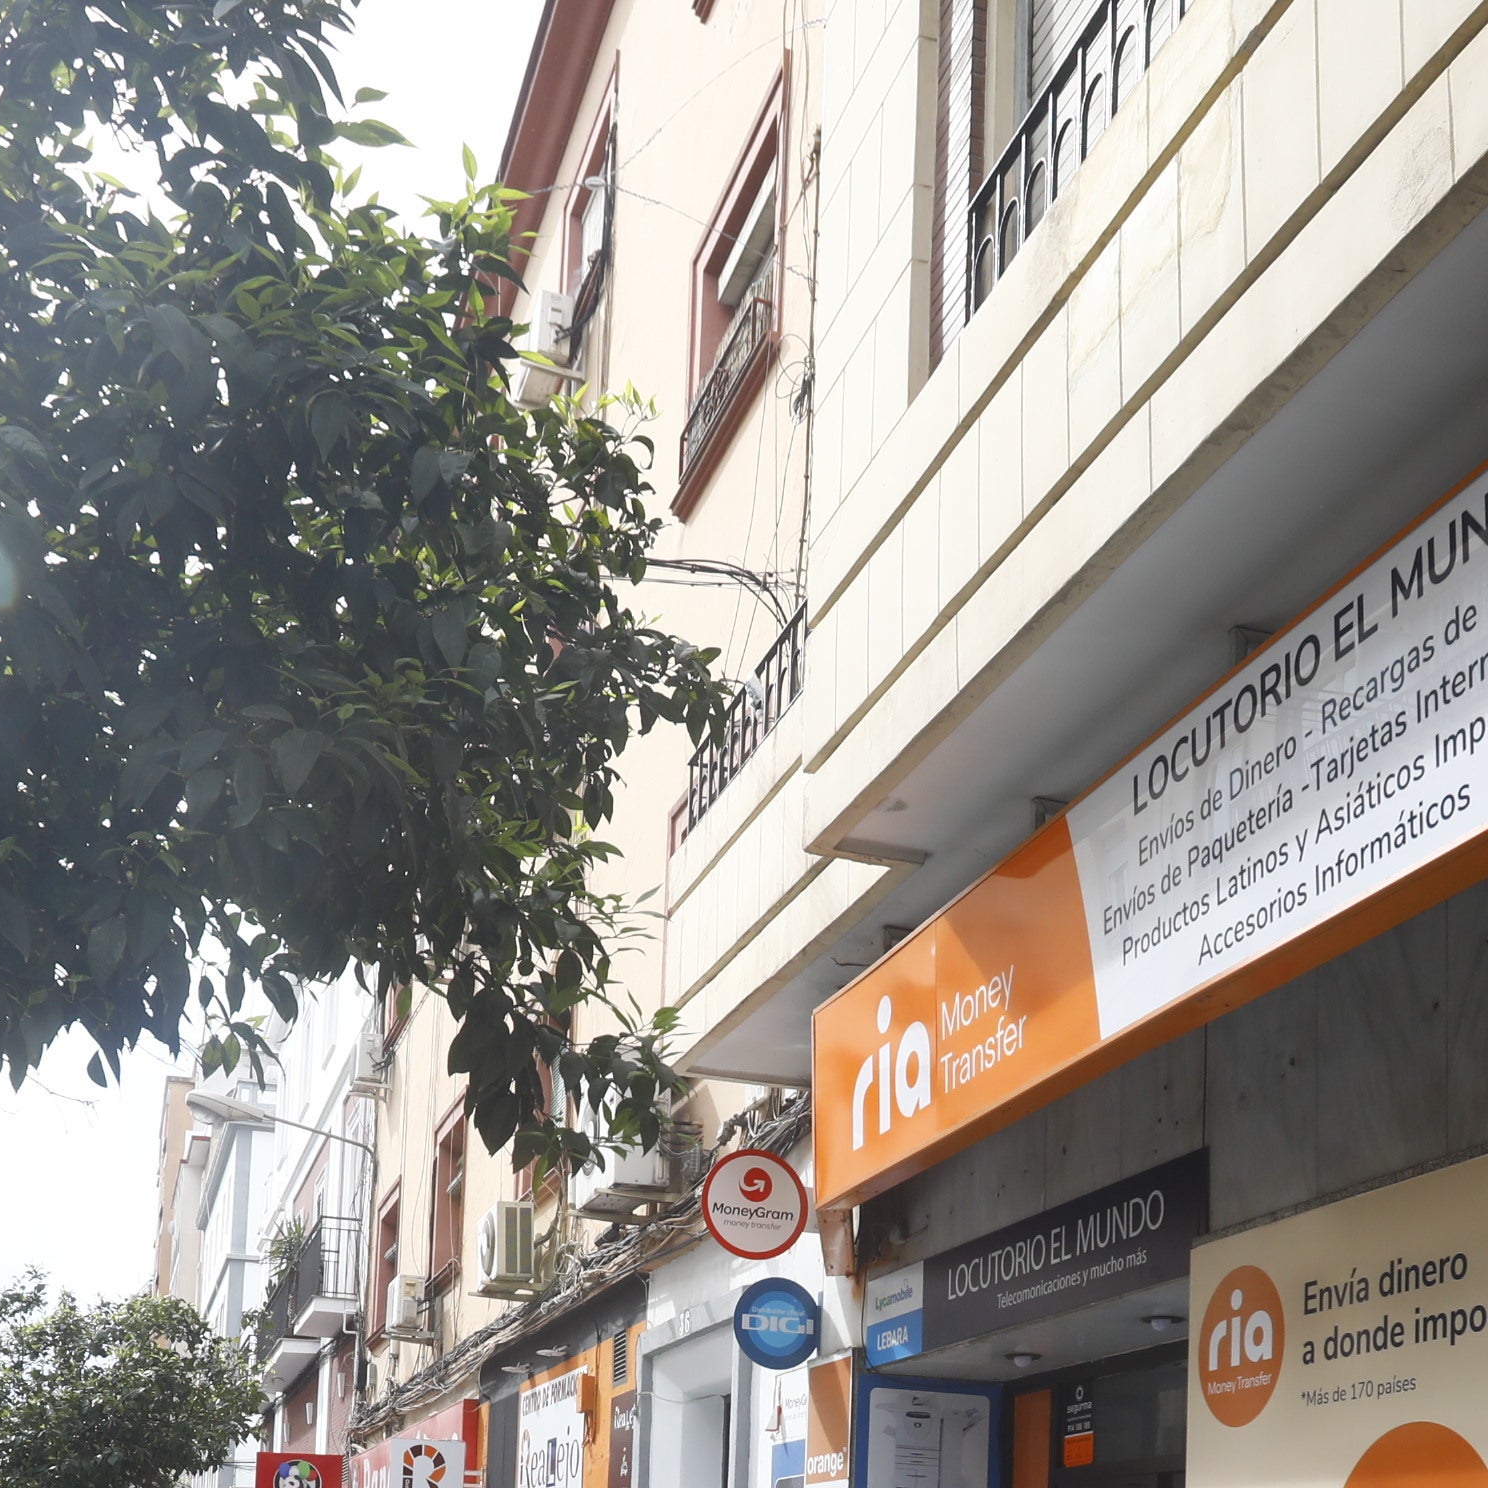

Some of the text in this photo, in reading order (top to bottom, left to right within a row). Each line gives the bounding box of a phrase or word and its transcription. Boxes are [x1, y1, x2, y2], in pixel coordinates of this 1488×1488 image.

[1132, 634, 1321, 816] LOCUTORIO
[1334, 593, 1378, 662] EL
[1138, 812, 1194, 867] Envíos
[1200, 788, 1223, 821] de
[1229, 736, 1297, 801] Dinero
[1322, 634, 1435, 735] Recargas
[1444, 604, 1477, 646] de
[1103, 882, 1156, 935] Envíos
[1161, 864, 1182, 895] de
[1188, 783, 1294, 877] Paquetería
[1122, 893, 1210, 966] Productos
[1217, 841, 1288, 906] Latinos
[1296, 829, 1308, 862] y
[1315, 754, 1425, 844] Asiáticos
[1198, 783, 1470, 965] Accesorios Informáticos
[941, 964, 1014, 1041] Money
[853, 995, 932, 1151] ria
[941, 1014, 1027, 1094] Transfer
[712, 1202, 794, 1221] MoneyGram
[723, 1219, 782, 1231] money transfer
[948, 1189, 1164, 1300] LOCUTORIO EL MUNDO
[1082, 1269, 1089, 1287] y
[1090, 1255, 1124, 1281] mucho
[1126, 1246, 1148, 1268] más
[1303, 1253, 1468, 1316] Envía dinero
[741, 1313, 814, 1335] DIGI
[877, 1326, 909, 1350] LEBARA
[1208, 1289, 1273, 1372] ria
[1302, 1340, 1315, 1366] a
[1323, 1316, 1404, 1361] donde
[1207, 1372, 1272, 1396] Money Transfer
[1332, 1386, 1347, 1403] de
[1351, 1380, 1373, 1401] 170
[1377, 1374, 1416, 1397] países
[807, 1452, 844, 1477] orange
